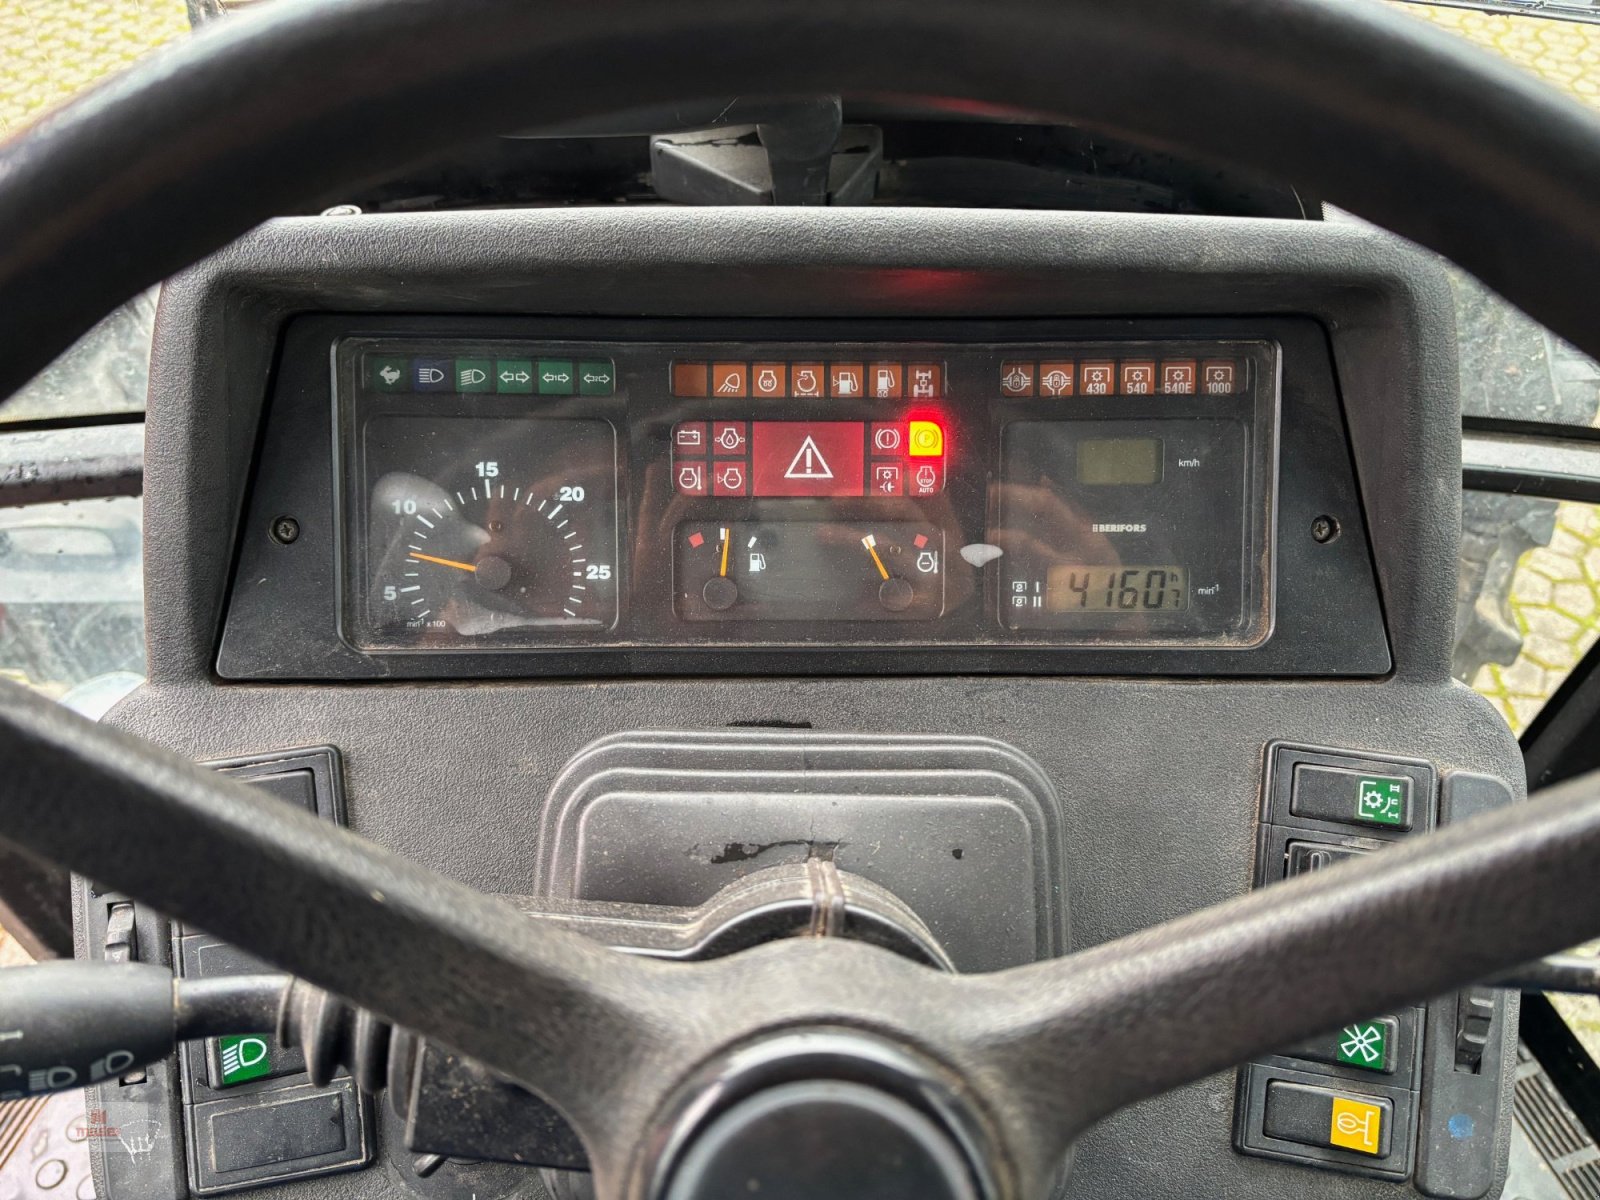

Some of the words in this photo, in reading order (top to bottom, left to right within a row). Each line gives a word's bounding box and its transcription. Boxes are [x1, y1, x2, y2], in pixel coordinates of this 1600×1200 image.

[1086, 382, 1106, 394] 430
[1126, 382, 1147, 394] 540
[1164, 382, 1192, 394] 540E
[1206, 382, 1231, 394] 1000
[475, 461, 499, 477] 15
[1178, 458, 1200, 468] km/h
[559, 486, 585, 502] 20
[391, 500, 417, 515] 10
[1098, 524, 1147, 533] BERIFORS
[585, 564, 611, 580] 25
[383, 586, 397, 600] 5
[1068, 570, 1167, 609] 4160
